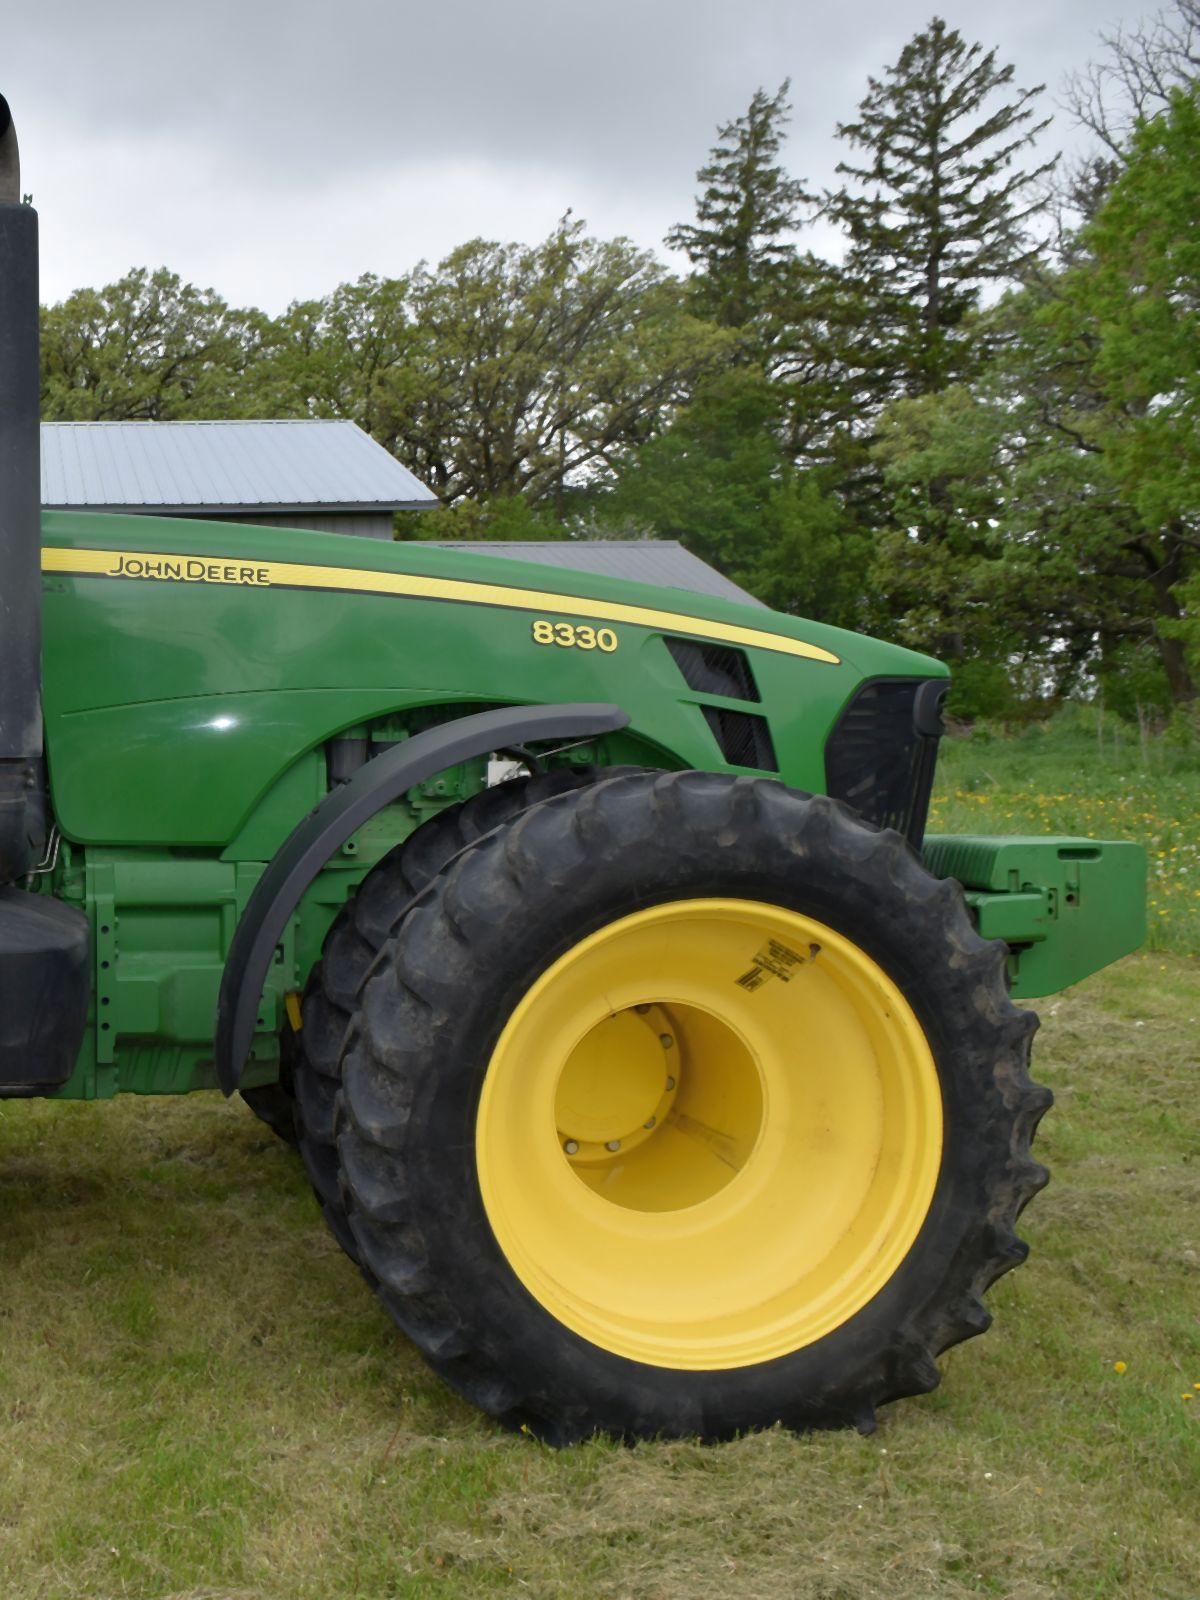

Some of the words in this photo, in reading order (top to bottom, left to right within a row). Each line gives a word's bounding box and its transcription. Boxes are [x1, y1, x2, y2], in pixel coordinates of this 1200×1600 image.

[110, 555, 181, 577] JOHN
[186, 560, 270, 583] DEERE
[532, 619, 618, 652] 8330
